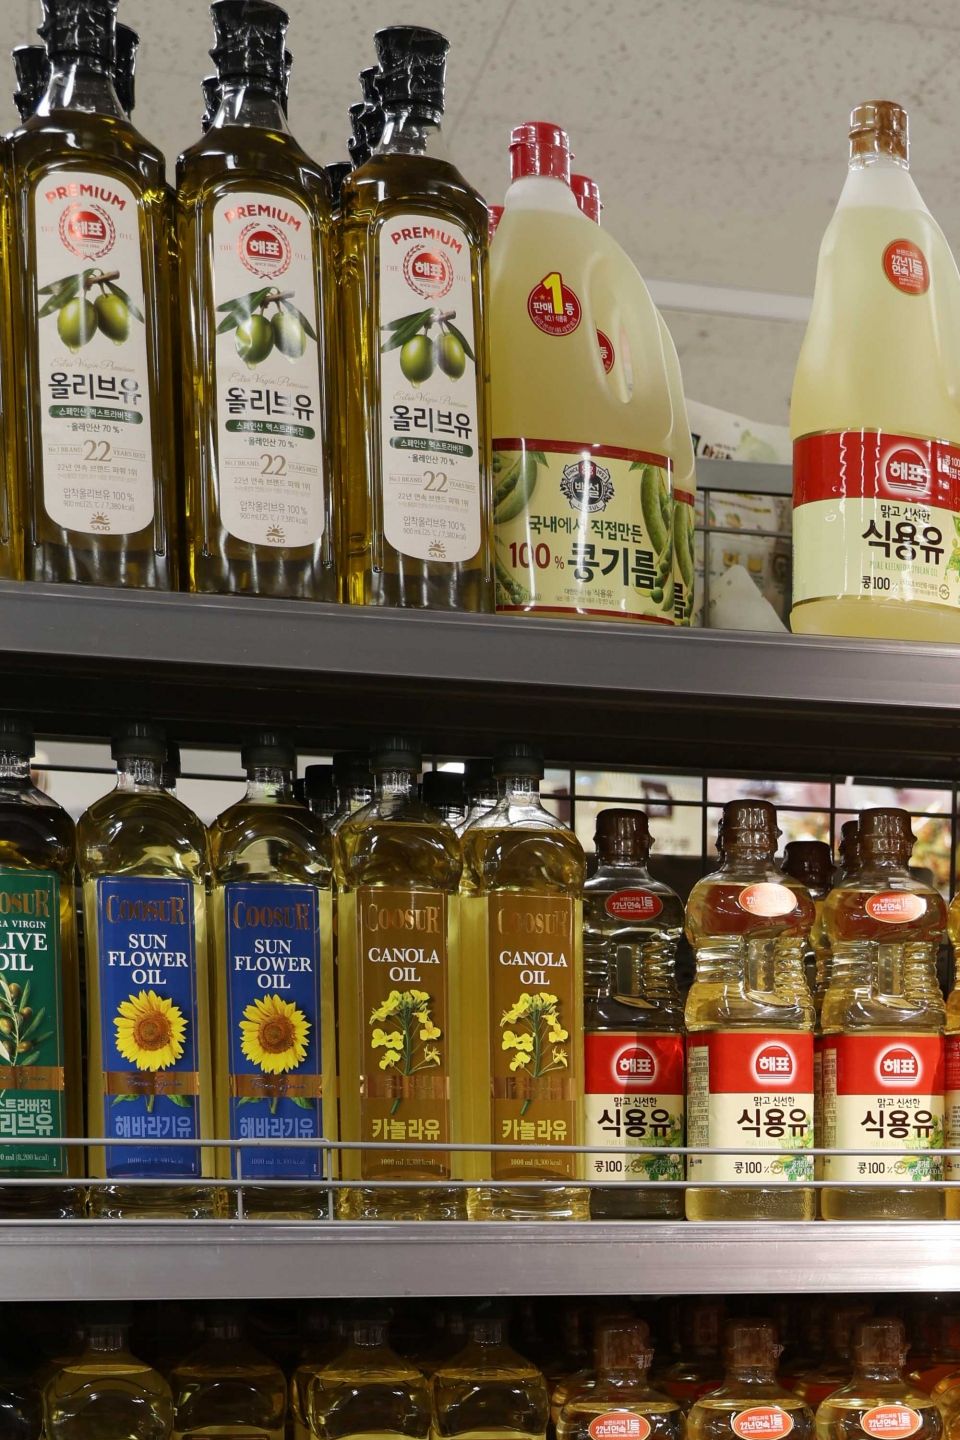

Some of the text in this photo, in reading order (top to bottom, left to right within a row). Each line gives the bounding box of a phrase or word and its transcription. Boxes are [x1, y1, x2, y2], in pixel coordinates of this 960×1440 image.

[390, 226, 463, 254] PREMIUM
[533, 273, 564, 315] 판매 1
[48, 372, 142, 406] 올리브유
[225, 387, 314, 421] 올리브유
[71, 423, 100, 433] 올레인산
[390, 405, 473, 439] 올리브유
[83, 439, 112, 462] 22
[260, 454, 287, 476] 22
[423, 471, 448, 493] 22
[590, 519, 643, 543] 직접만든
[861, 520, 945, 565] 식용유
[509, 542, 658, 590] 100 콩기름
[106, 894, 186, 926] COOSUR
[233, 901, 310, 930] COOSUR
[12, 920, 47, 929] VIRGIN
[128, 934, 167, 949] SUN
[254, 939, 292, 955] SUN
[108, 951, 188, 968] FLOWER
[234, 956, 313, 972] FLOWER
[368, 948, 440, 964] CANOLA
[499, 951, 568, 968] CANOLA
[131, 969, 167, 985] OIL
[257, 973, 291, 990] OIL
[389, 967, 421, 982] OIL
[520, 970, 550, 985] OIL
[115, 1115, 192, 1138] 해바라기유
[239, 1117, 314, 1139] 해바라기유
[372, 1119, 441, 1141] 카놀라유
[502, 1119, 567, 1141] 카놀라유
[597, 1108, 671, 1138] 식용유
[736, 1108, 808, 1138] 식용유
[860, 1109, 935, 1139] 식용유
